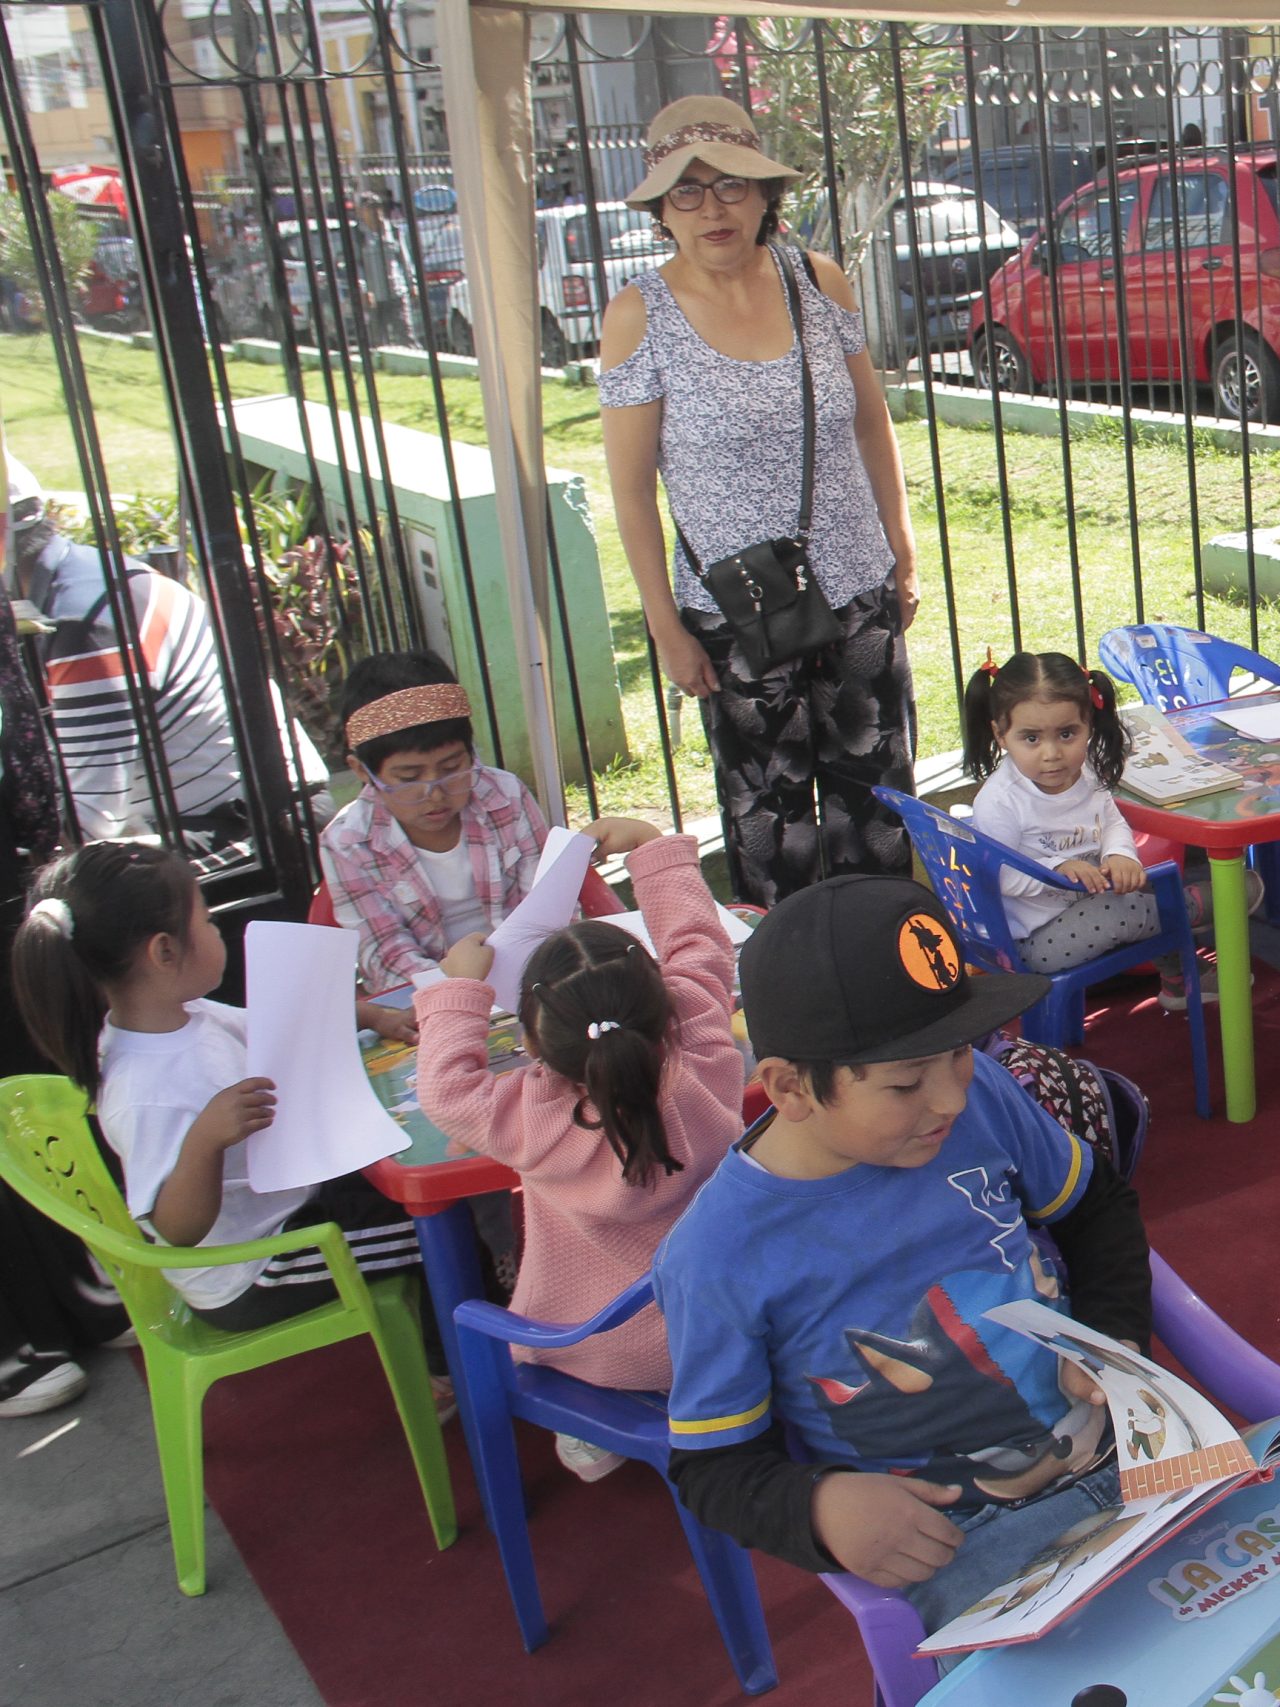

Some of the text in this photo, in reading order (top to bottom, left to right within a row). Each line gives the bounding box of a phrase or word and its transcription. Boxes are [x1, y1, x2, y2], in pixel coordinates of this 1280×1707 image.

[1158, 1562, 1223, 1605] LA
[1179, 1606, 1194, 1616] de
[1197, 1563, 1270, 1613] MICKEY
